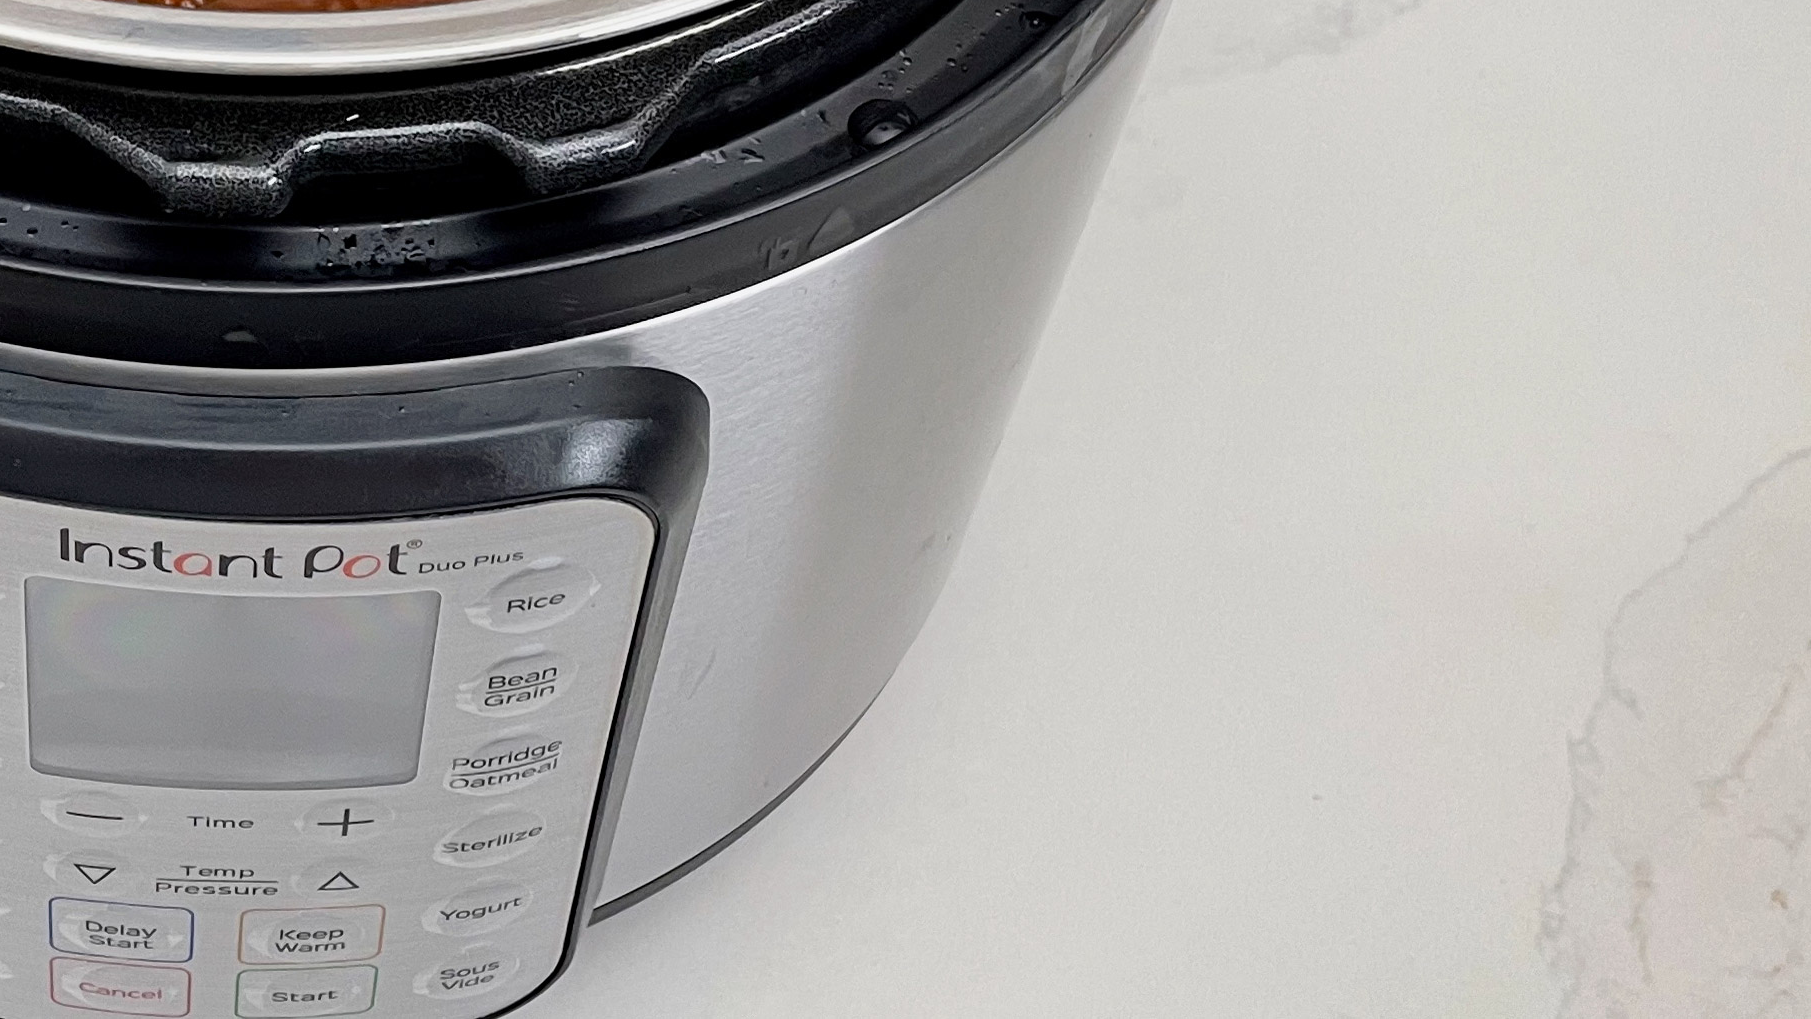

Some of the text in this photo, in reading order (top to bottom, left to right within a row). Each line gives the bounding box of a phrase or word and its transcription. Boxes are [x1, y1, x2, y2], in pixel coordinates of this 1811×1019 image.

[59, 527, 284, 579] Instant
[418, 548, 525, 575] Duo Plus
[506, 593, 566, 614] Rice
[488, 666, 558, 690] Bean
[484, 685, 555, 707] Grain
[451, 740, 563, 771] Porridge
[448, 758, 558, 789] Oatmeal
[187, 815, 255, 829] Time
[441, 826, 543, 854] Sterilize
[180, 864, 255, 880] Temp
[155, 882, 279, 896] Pressure
[439, 897, 523, 921] Yogurt
[84, 919, 157, 939] Delay
[279, 928, 345, 942] Keep
[88, 934, 154, 950] Start
[275, 940, 346, 954] Warm
[439, 961, 500, 980] Sous
[79, 982, 163, 1001] Cancel
[441, 974, 495, 990] Vide
[271, 990, 340, 1003] Start
